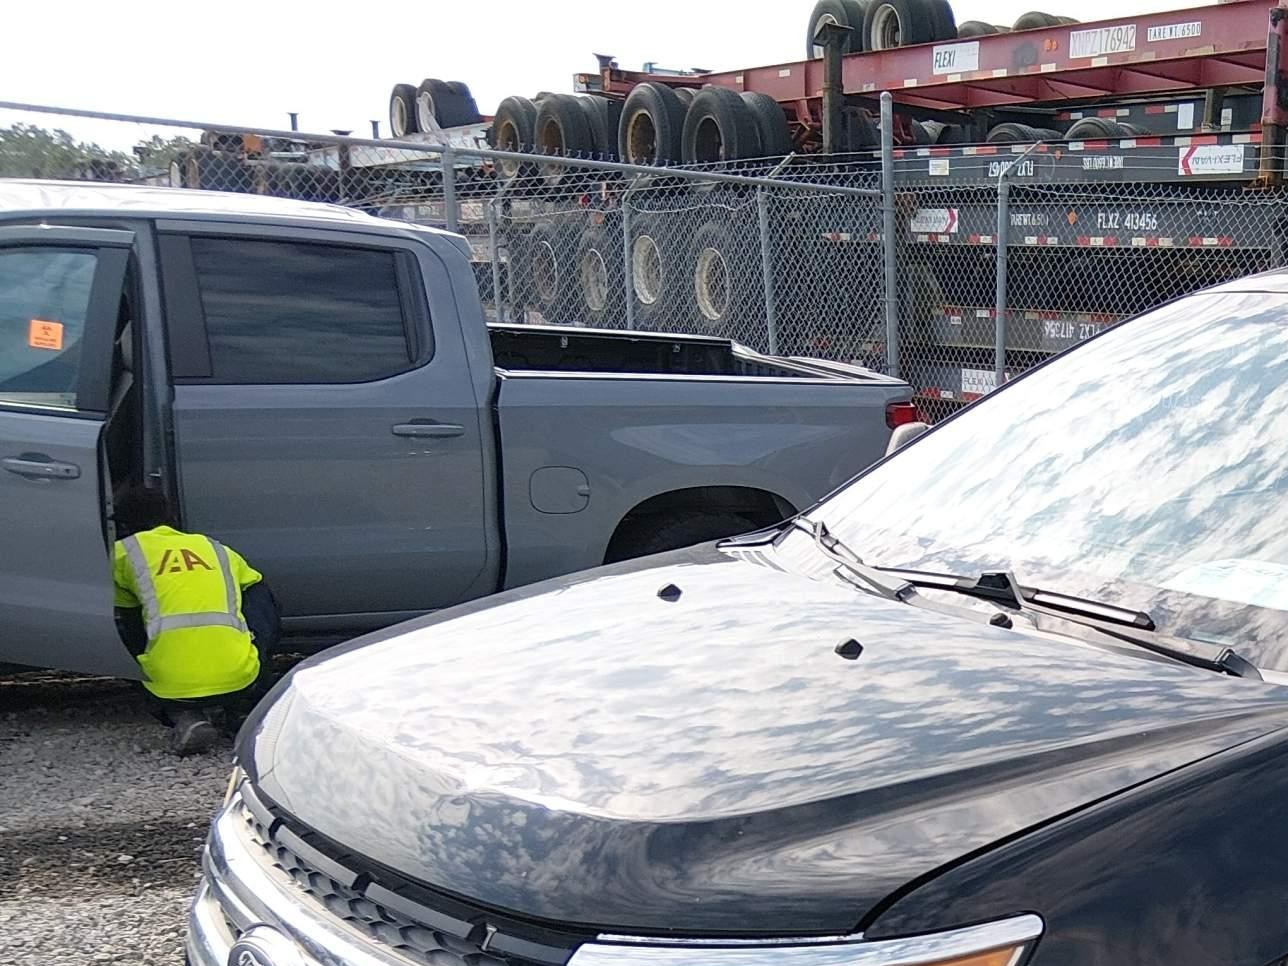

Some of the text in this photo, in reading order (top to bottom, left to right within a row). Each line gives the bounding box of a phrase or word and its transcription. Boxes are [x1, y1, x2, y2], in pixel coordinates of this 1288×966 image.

[1148, 27, 1167, 41] TARE
[1181, 23, 1200, 36] 6500
[1097, 212, 1158, 230] FLXZ 413456
